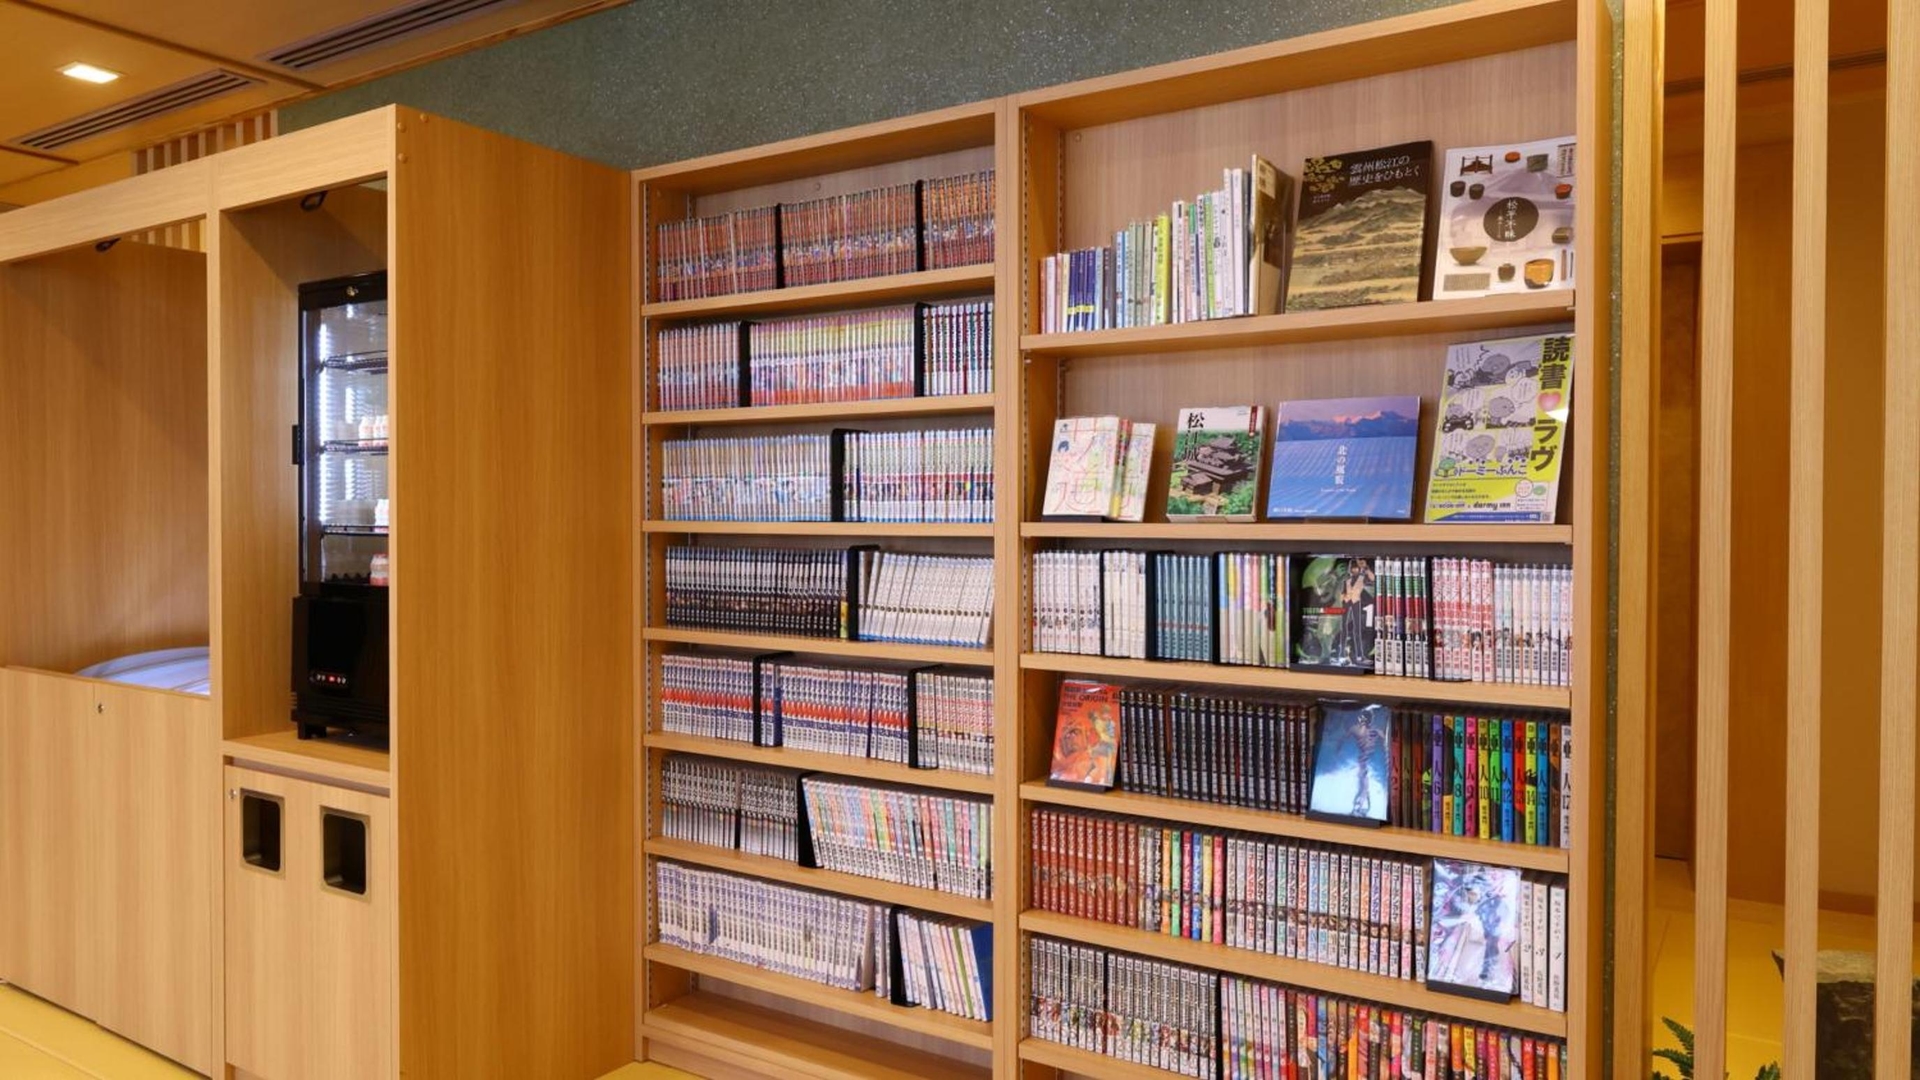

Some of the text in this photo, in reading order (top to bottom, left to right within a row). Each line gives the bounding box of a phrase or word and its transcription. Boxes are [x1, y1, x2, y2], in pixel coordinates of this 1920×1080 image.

[1350, 155, 1410, 175] 雲州松江の
[1350, 165, 1420, 187] 歴史をひもとく
[1539, 336, 1572, 391] 読書
[1530, 418, 1559, 472] ラヴ
[1362, 603, 1374, 627] 1
[1433, 780, 1443, 796] 6
[1454, 782, 1463, 798] 8
[1465, 784, 1475, 802] 9
[1480, 784, 1489, 800] 10
